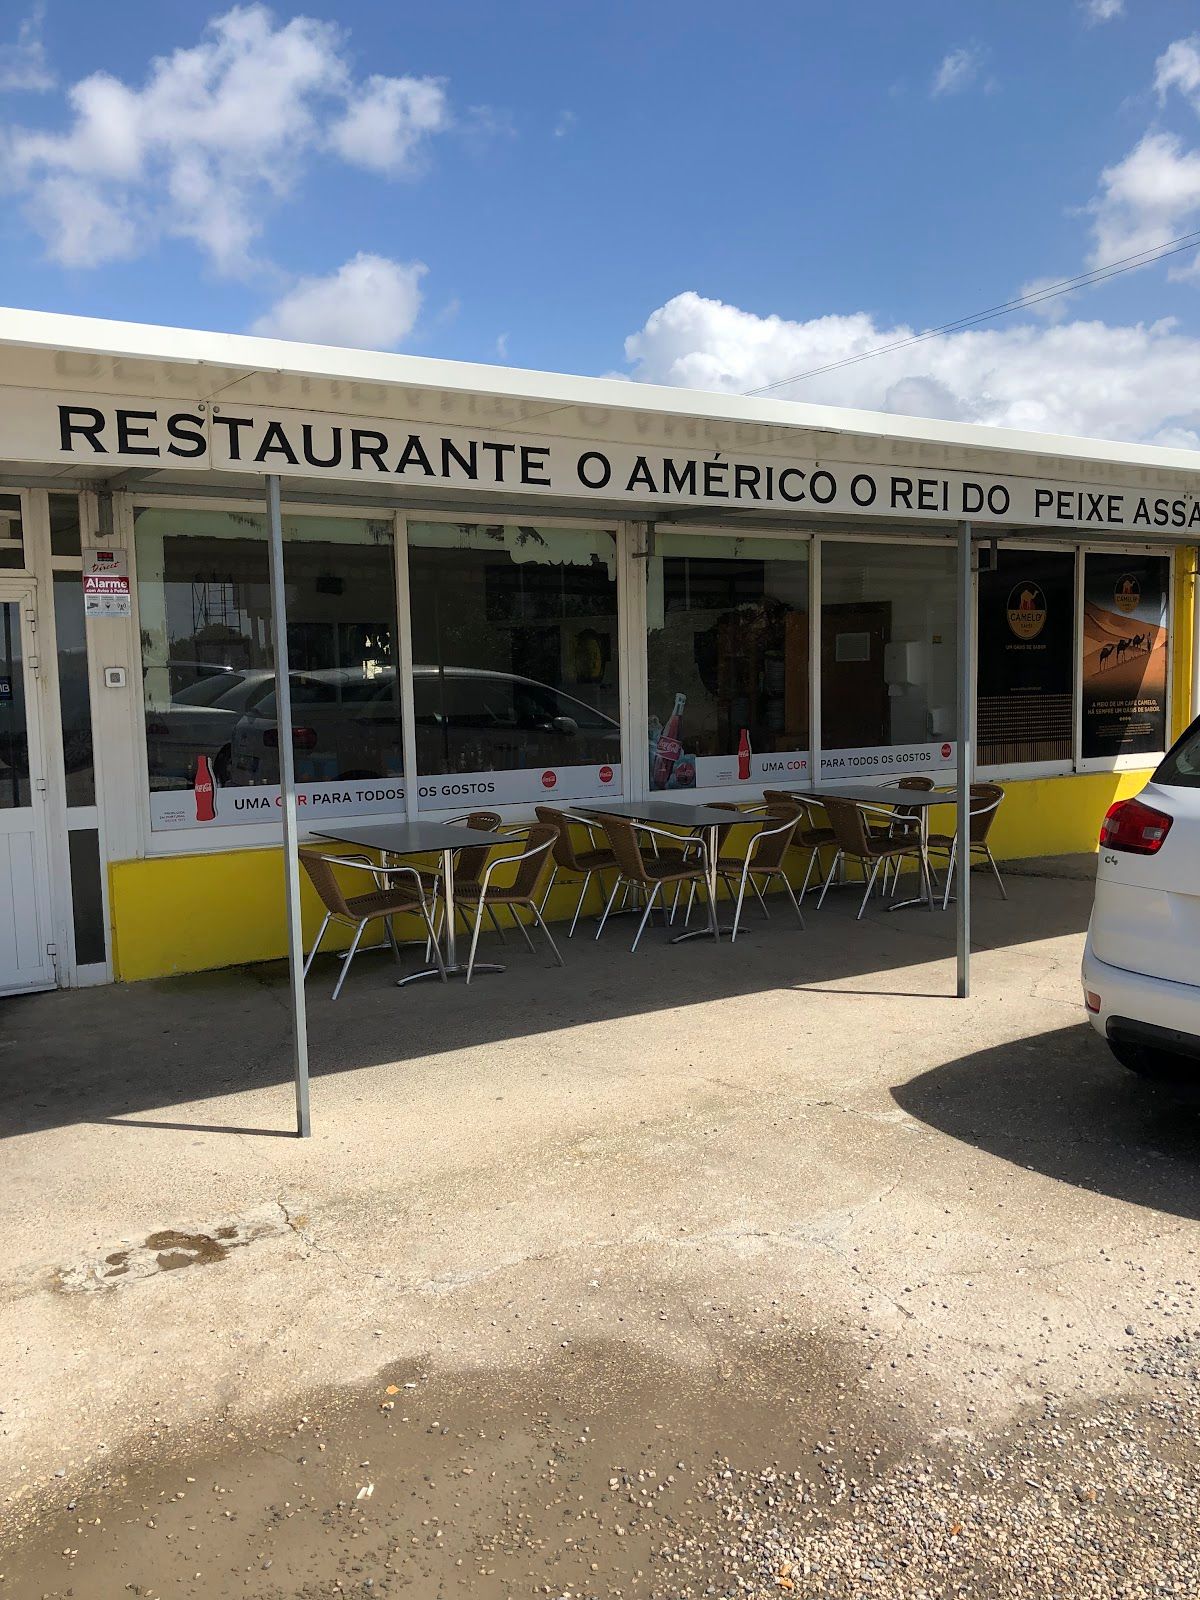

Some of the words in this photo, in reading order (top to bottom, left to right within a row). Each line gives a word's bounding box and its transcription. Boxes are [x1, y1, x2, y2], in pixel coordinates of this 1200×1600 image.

[57, 404, 551, 487] RESTAURANTE
[577, 451, 612, 489] O
[625, 452, 837, 504] AMÉRICO
[850, 474, 877, 507] O
[890, 476, 949, 512] REI
[962, 482, 1010, 515] DO
[1035, 488, 1124, 524] PEIXE
[86, 578, 127, 588] Alarme
[762, 761, 785, 772] UMA
[787, 760, 807, 770] COR
[820, 757, 845, 769] PARA
[847, 754, 879, 767] TODOS
[881, 754, 894, 764] OS
[896, 752, 931, 763] GOSTOS
[234, 797, 271, 810] UMA
[312, 791, 352, 805] PARA
[356, 788, 405, 802] TODOS
[418, 786, 437, 798] OS
[441, 782, 495, 796] GOSTOS
[1105, 855, 1118, 866] C4
